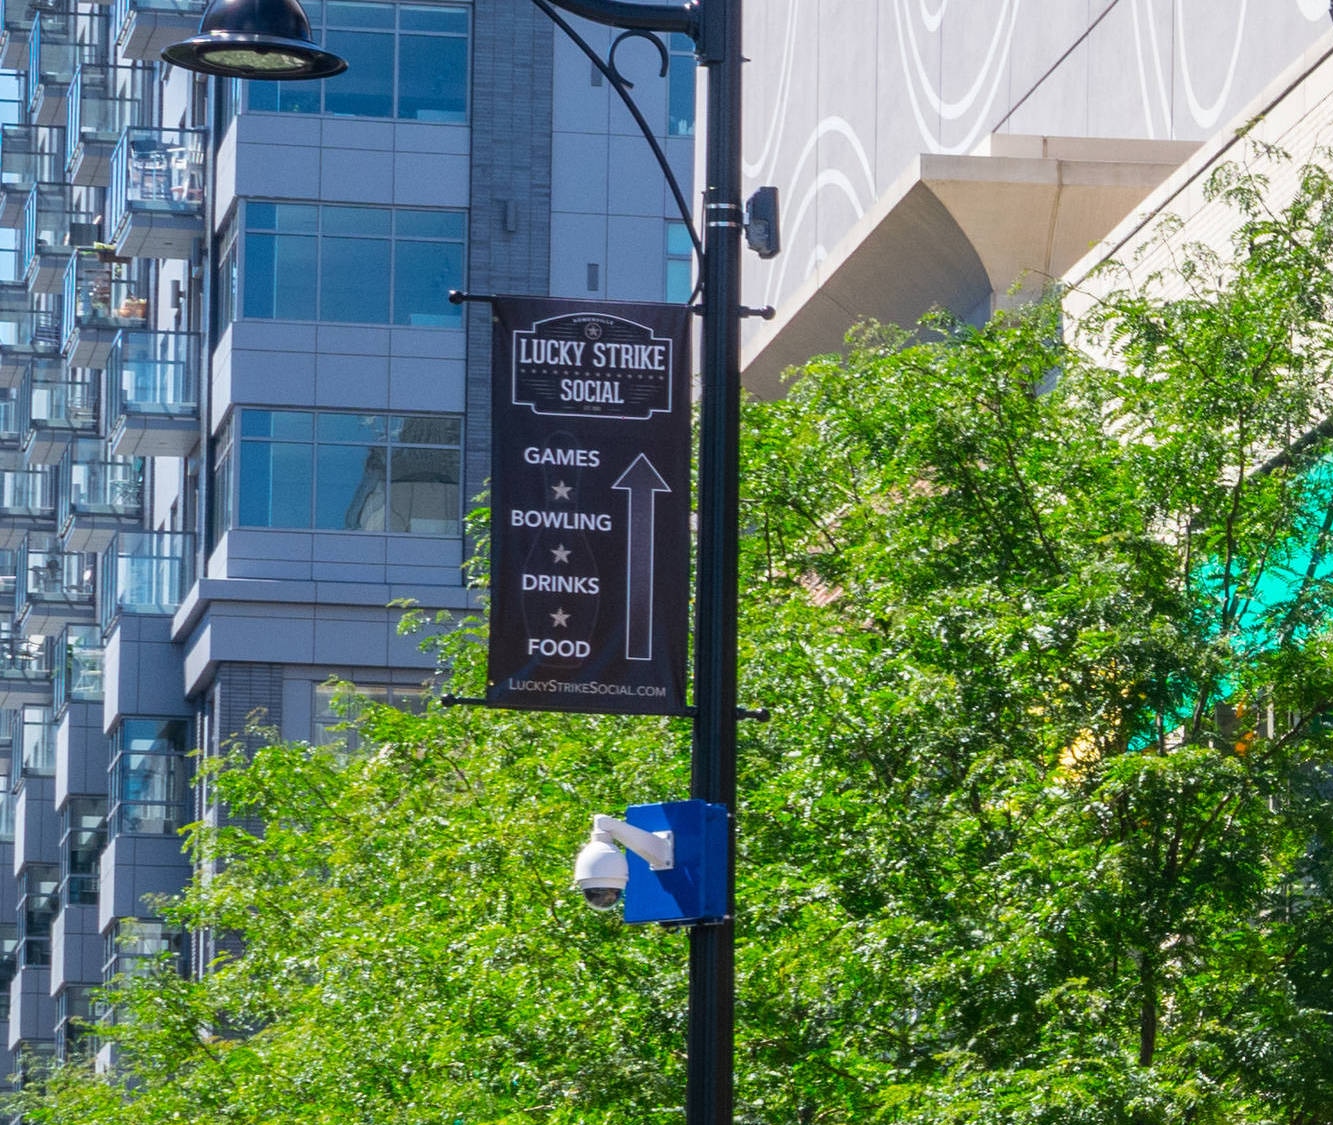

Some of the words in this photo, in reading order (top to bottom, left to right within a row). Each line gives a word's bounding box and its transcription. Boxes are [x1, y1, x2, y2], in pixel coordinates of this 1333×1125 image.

[520, 338, 585, 366] LUCKY
[592, 343, 666, 370] STRIKE
[560, 379, 624, 403] SOCIAL
[524, 447, 600, 467] GAMES
[511, 510, 612, 531] BOWLING
[522, 574, 599, 594] DRINKS
[528, 639, 590, 658] FOOD
